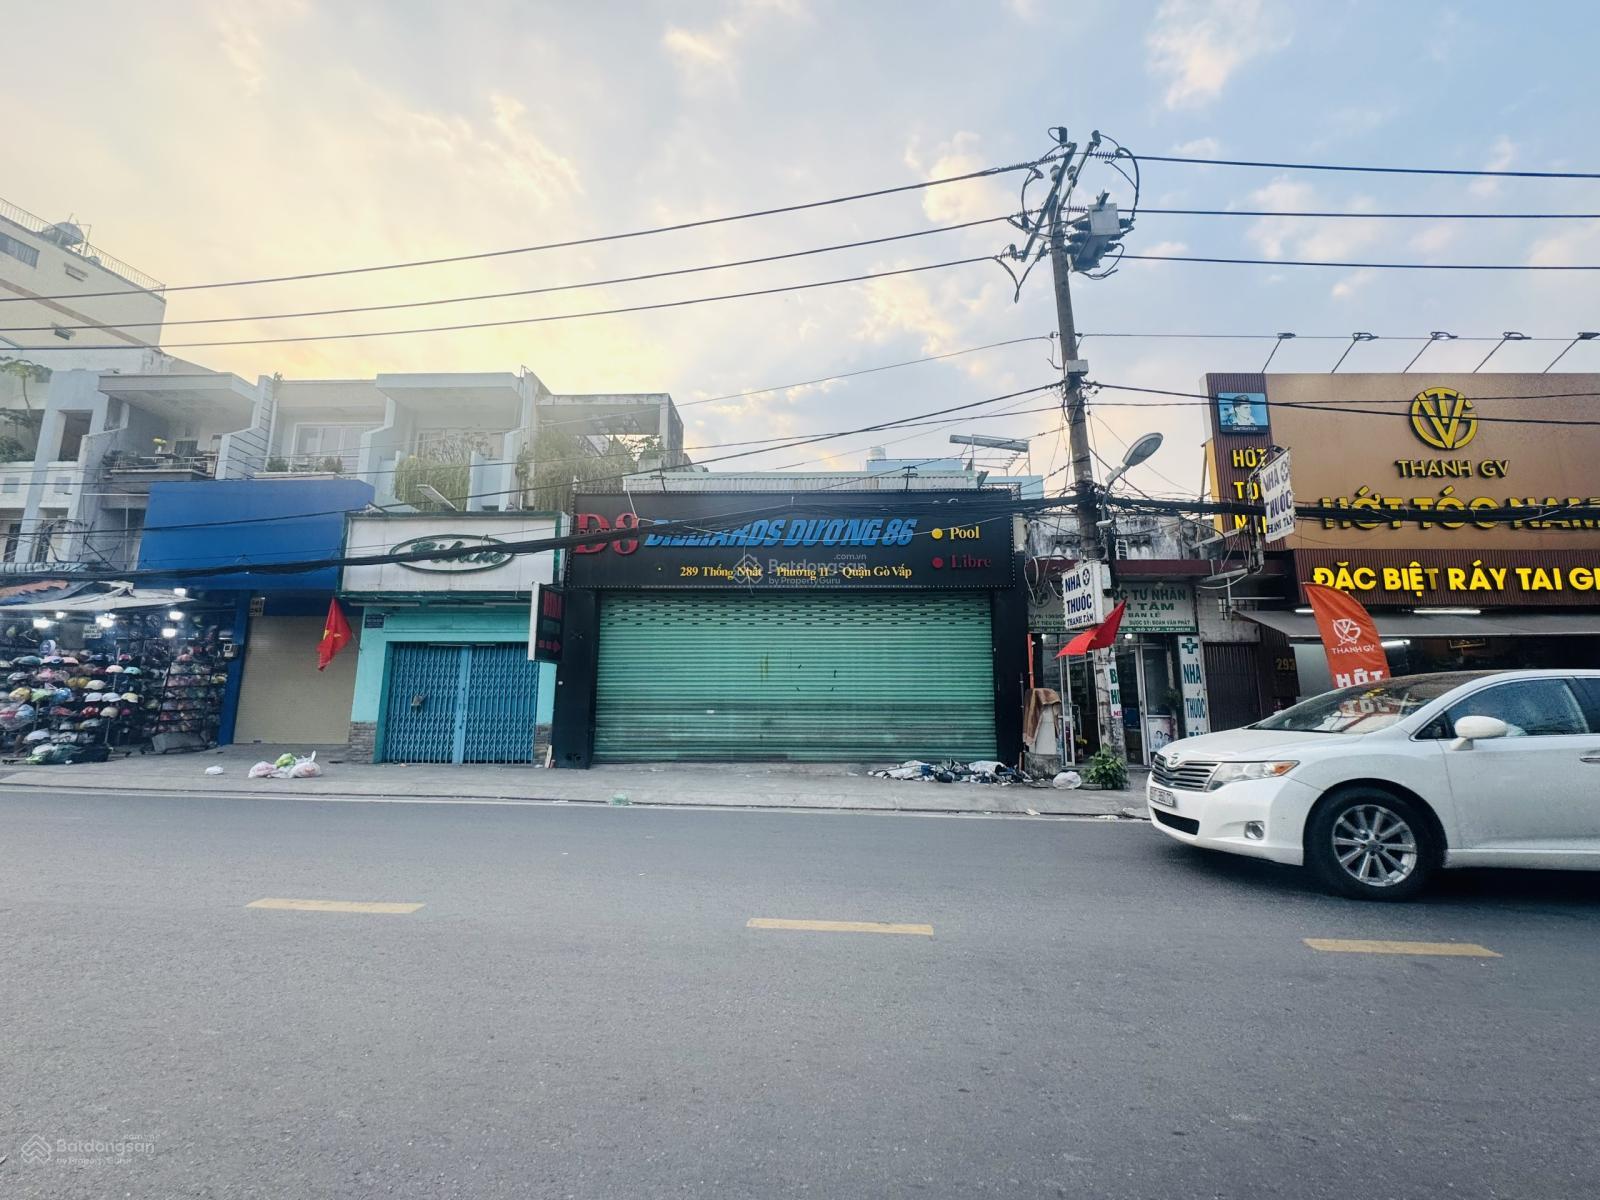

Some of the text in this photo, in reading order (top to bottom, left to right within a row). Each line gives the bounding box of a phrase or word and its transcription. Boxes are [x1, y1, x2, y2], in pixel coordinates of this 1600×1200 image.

[1398, 460, 1510, 476] THANH GV
[884, 518, 918, 547] 86
[950, 526, 980, 540] Pool
[680, 566, 698, 577] 289
[873, 565, 890, 577] Gò
[951, 553, 992, 569] Libre
[1064, 571, 1081, 593] NHÀ
[1383, 560, 1439, 597] BIỆT
[1448, 559, 1507, 591] RÁY
[1515, 567, 1562, 591] TAI
[1066, 590, 1092, 615] THUỐC
[1183, 657, 1201, 684] NHÀ
